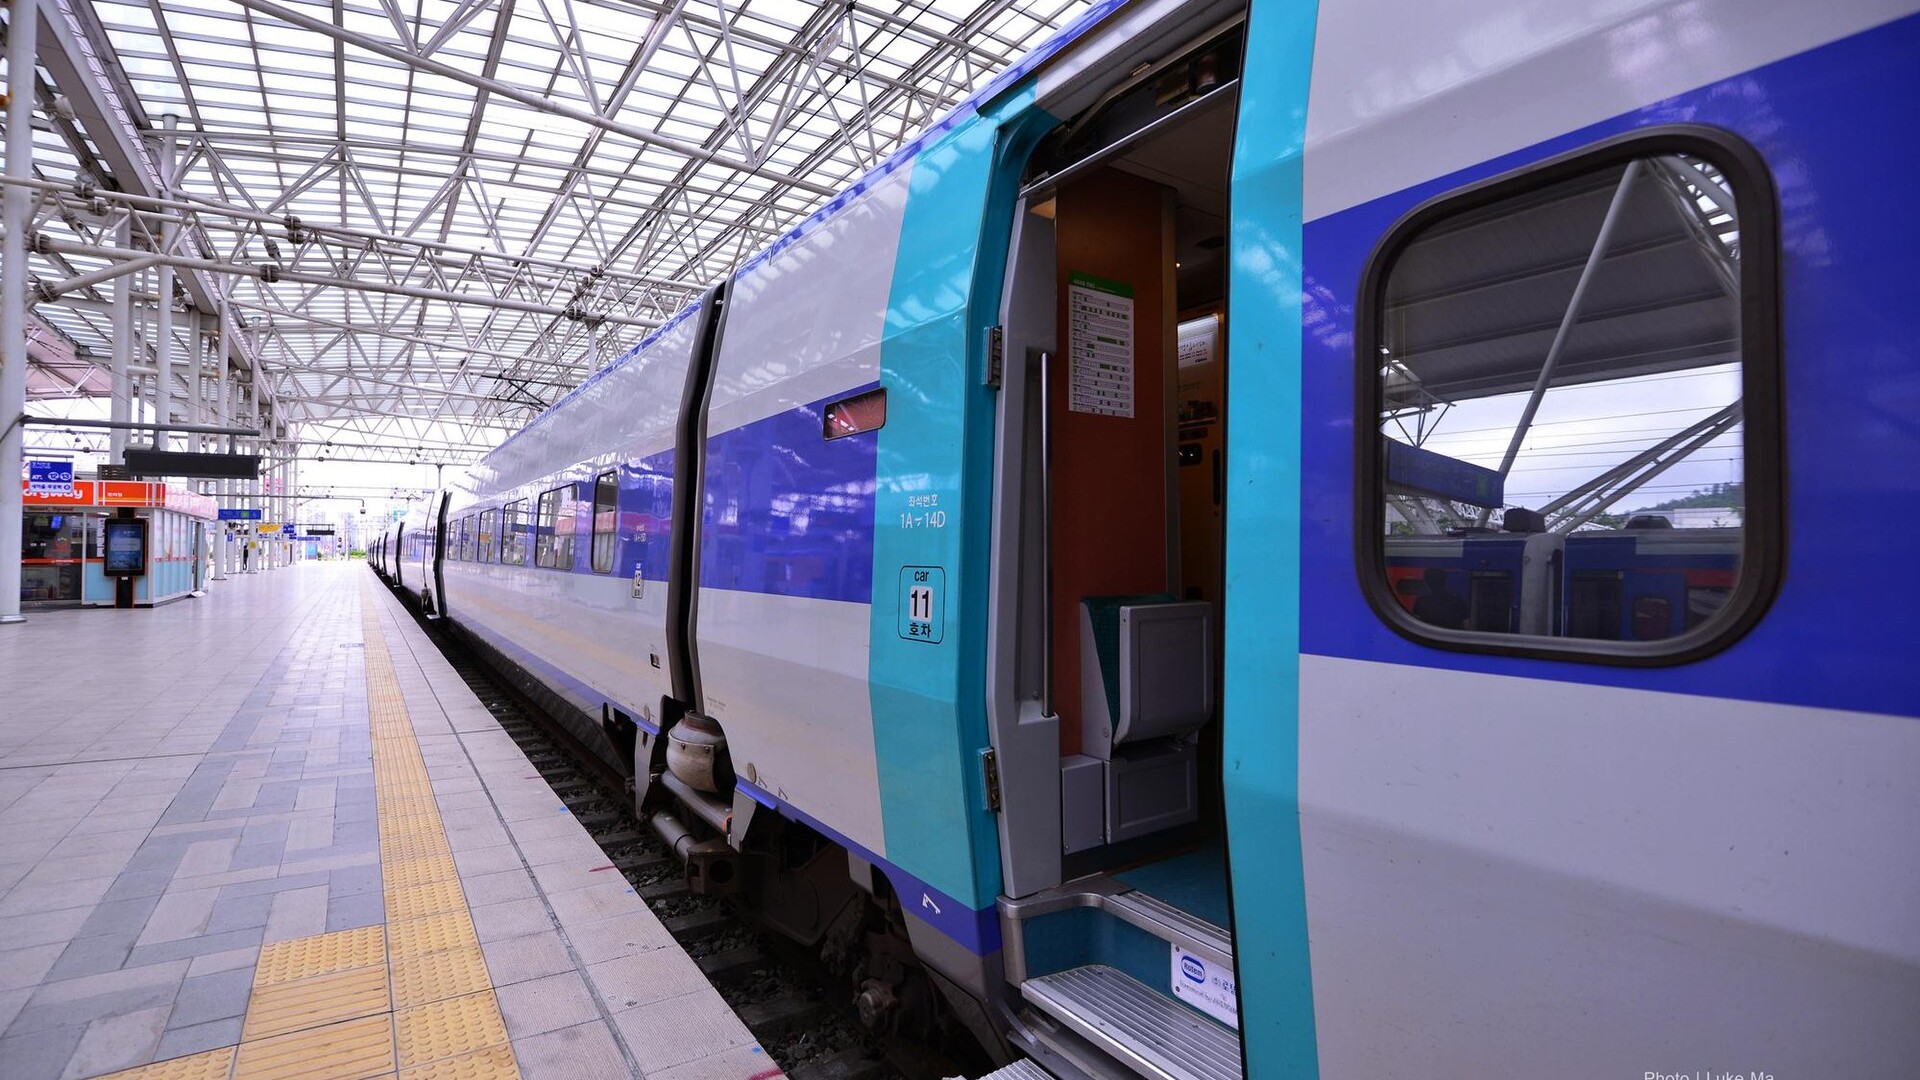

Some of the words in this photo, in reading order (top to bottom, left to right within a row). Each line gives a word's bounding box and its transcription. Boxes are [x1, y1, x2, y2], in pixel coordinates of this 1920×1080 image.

[914, 570, 929, 582] car
[911, 589, 929, 618] 11
[908, 622, 931, 638] 호차
